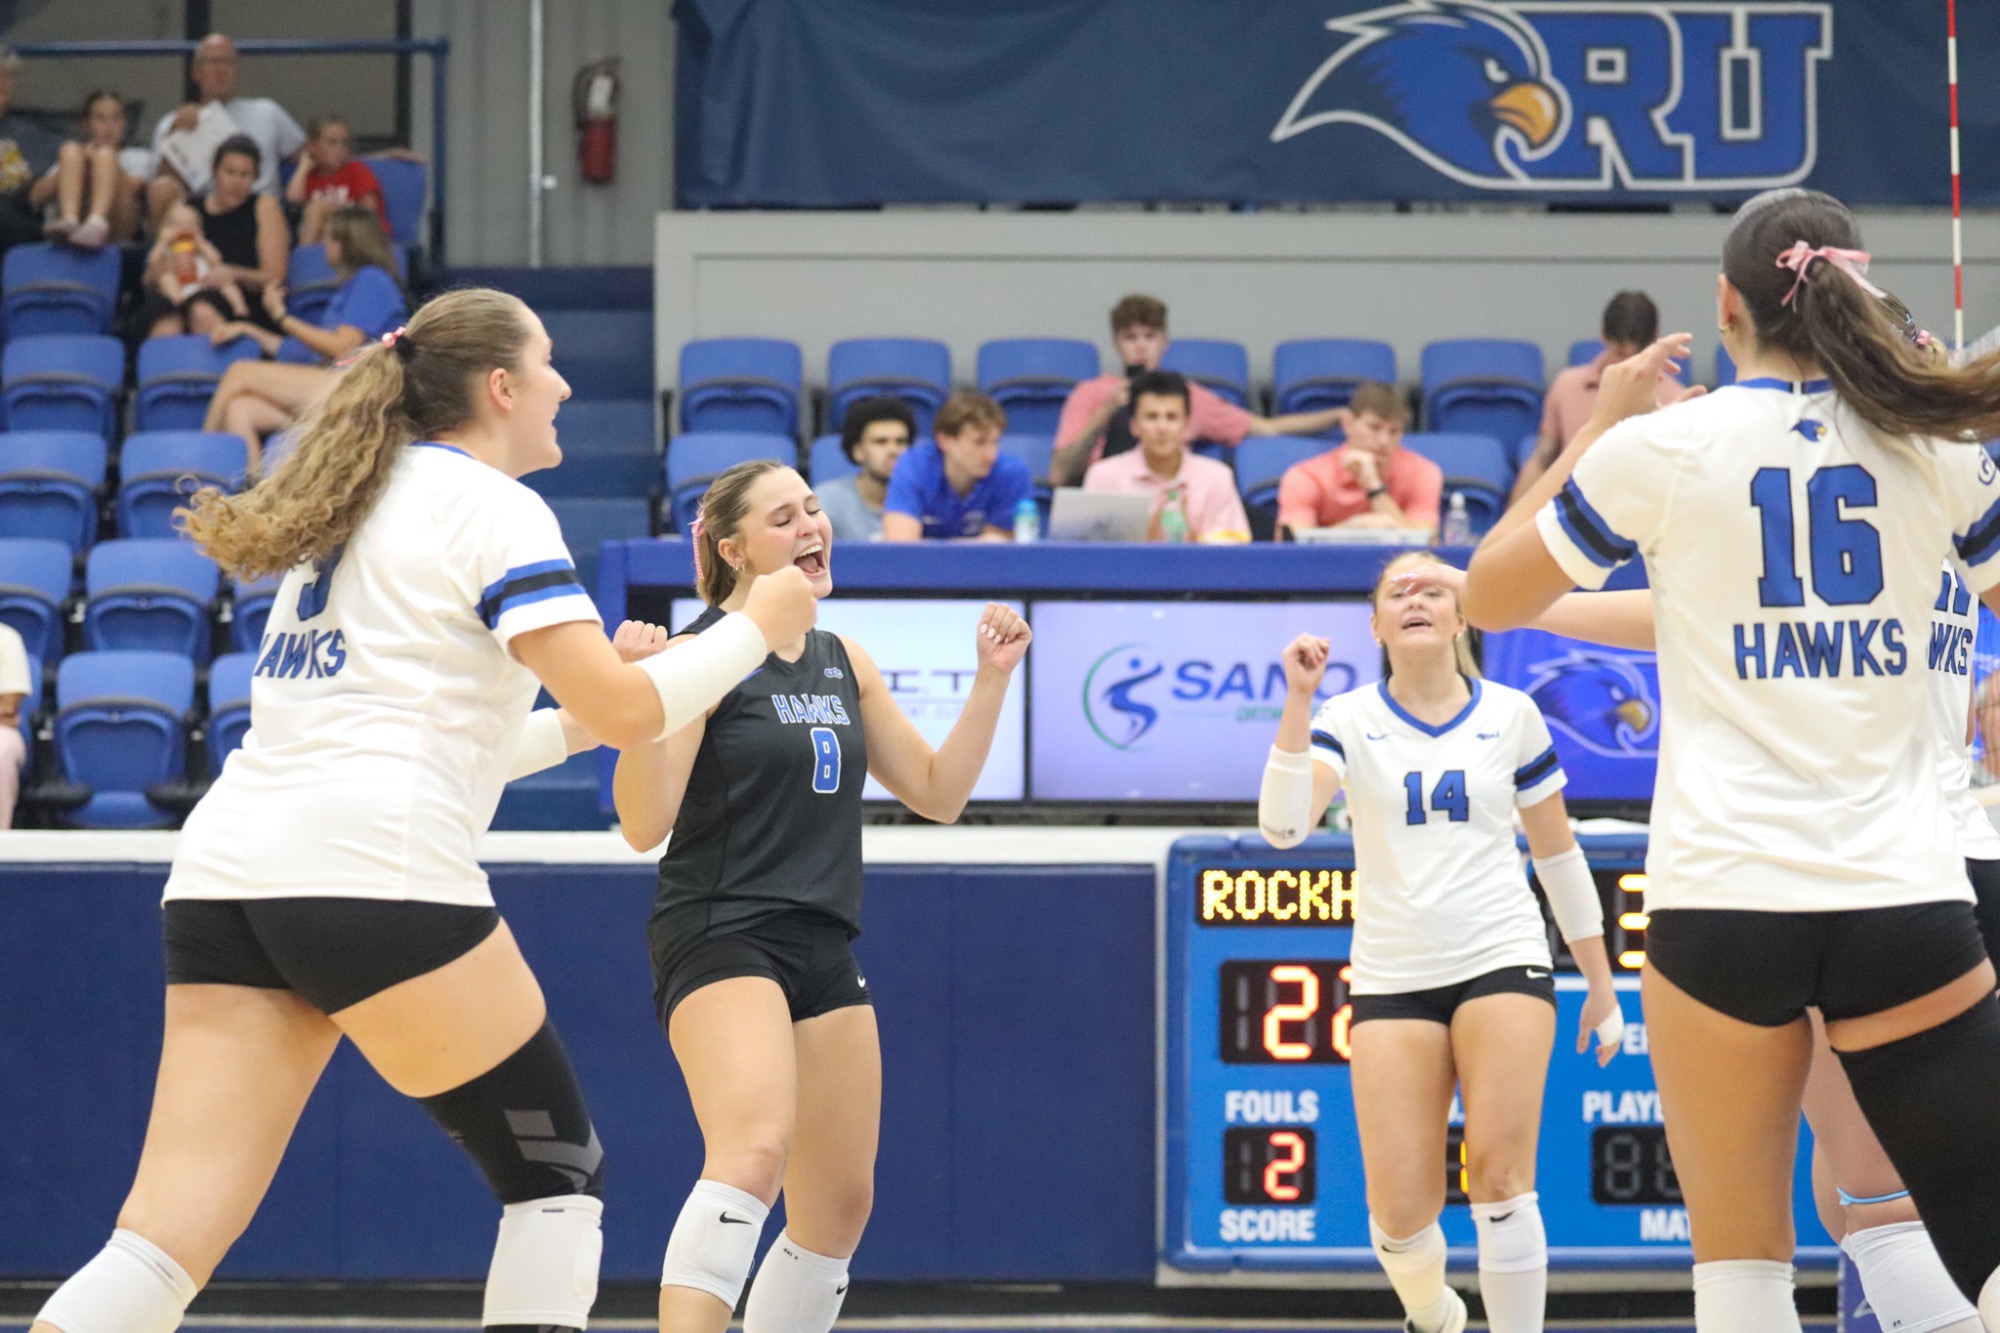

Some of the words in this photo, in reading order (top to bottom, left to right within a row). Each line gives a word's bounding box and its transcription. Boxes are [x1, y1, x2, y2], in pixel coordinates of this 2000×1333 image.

[1545, 4, 1833, 190] RU
[1750, 463, 1884, 607] 16
[253, 628, 347, 680] AWKS
[1733, 618, 1908, 680] HAWKS
[1927, 620, 1974, 677] WKS
[771, 693, 851, 726] HAWKS
[810, 727, 842, 794] 8
[1404, 769, 1470, 826] 14
[1203, 870, 1359, 920] ROCKH
[1225, 1089, 1319, 1123] FOULS
[1263, 1131, 1306, 1201] 2
[1219, 1208, 1316, 1242] SCORE
